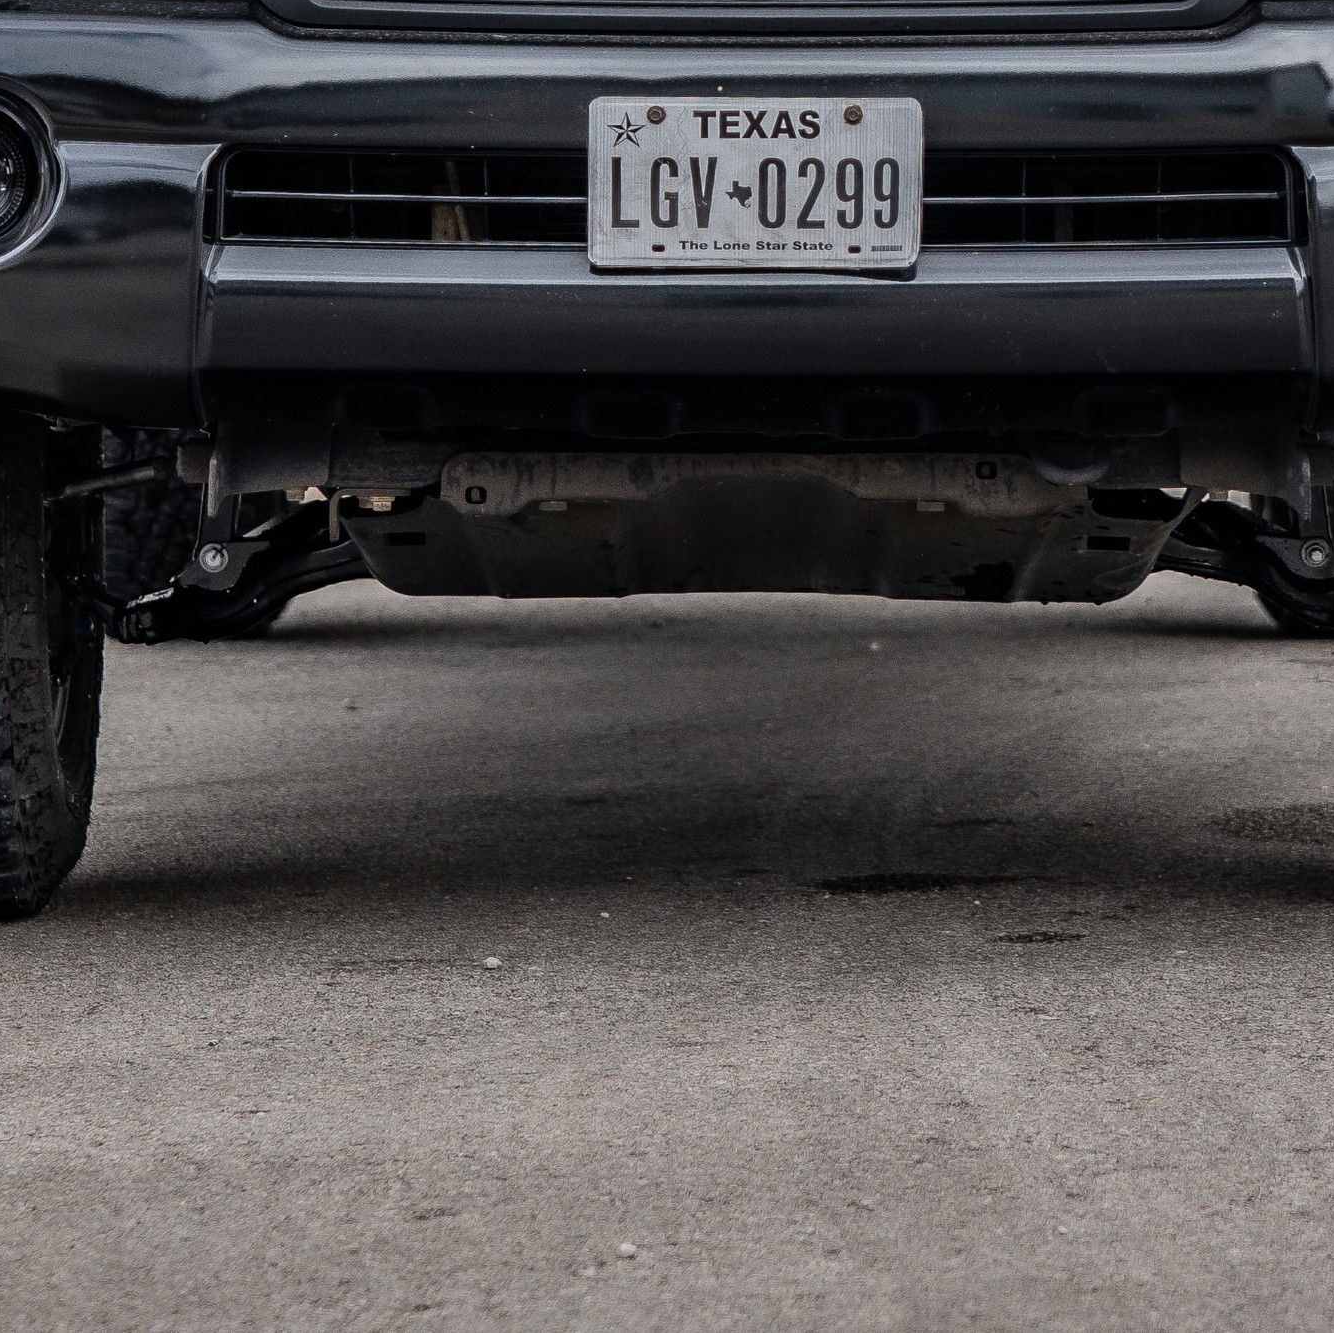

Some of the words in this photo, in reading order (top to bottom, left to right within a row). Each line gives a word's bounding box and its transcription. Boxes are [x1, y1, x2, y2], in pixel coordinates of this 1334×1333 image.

[693, 109, 821, 139] TEXAS
[678, 240, 709, 252] The
[713, 240, 751, 252] Lone
[755, 240, 790, 252] Star
[792, 240, 834, 252] State
